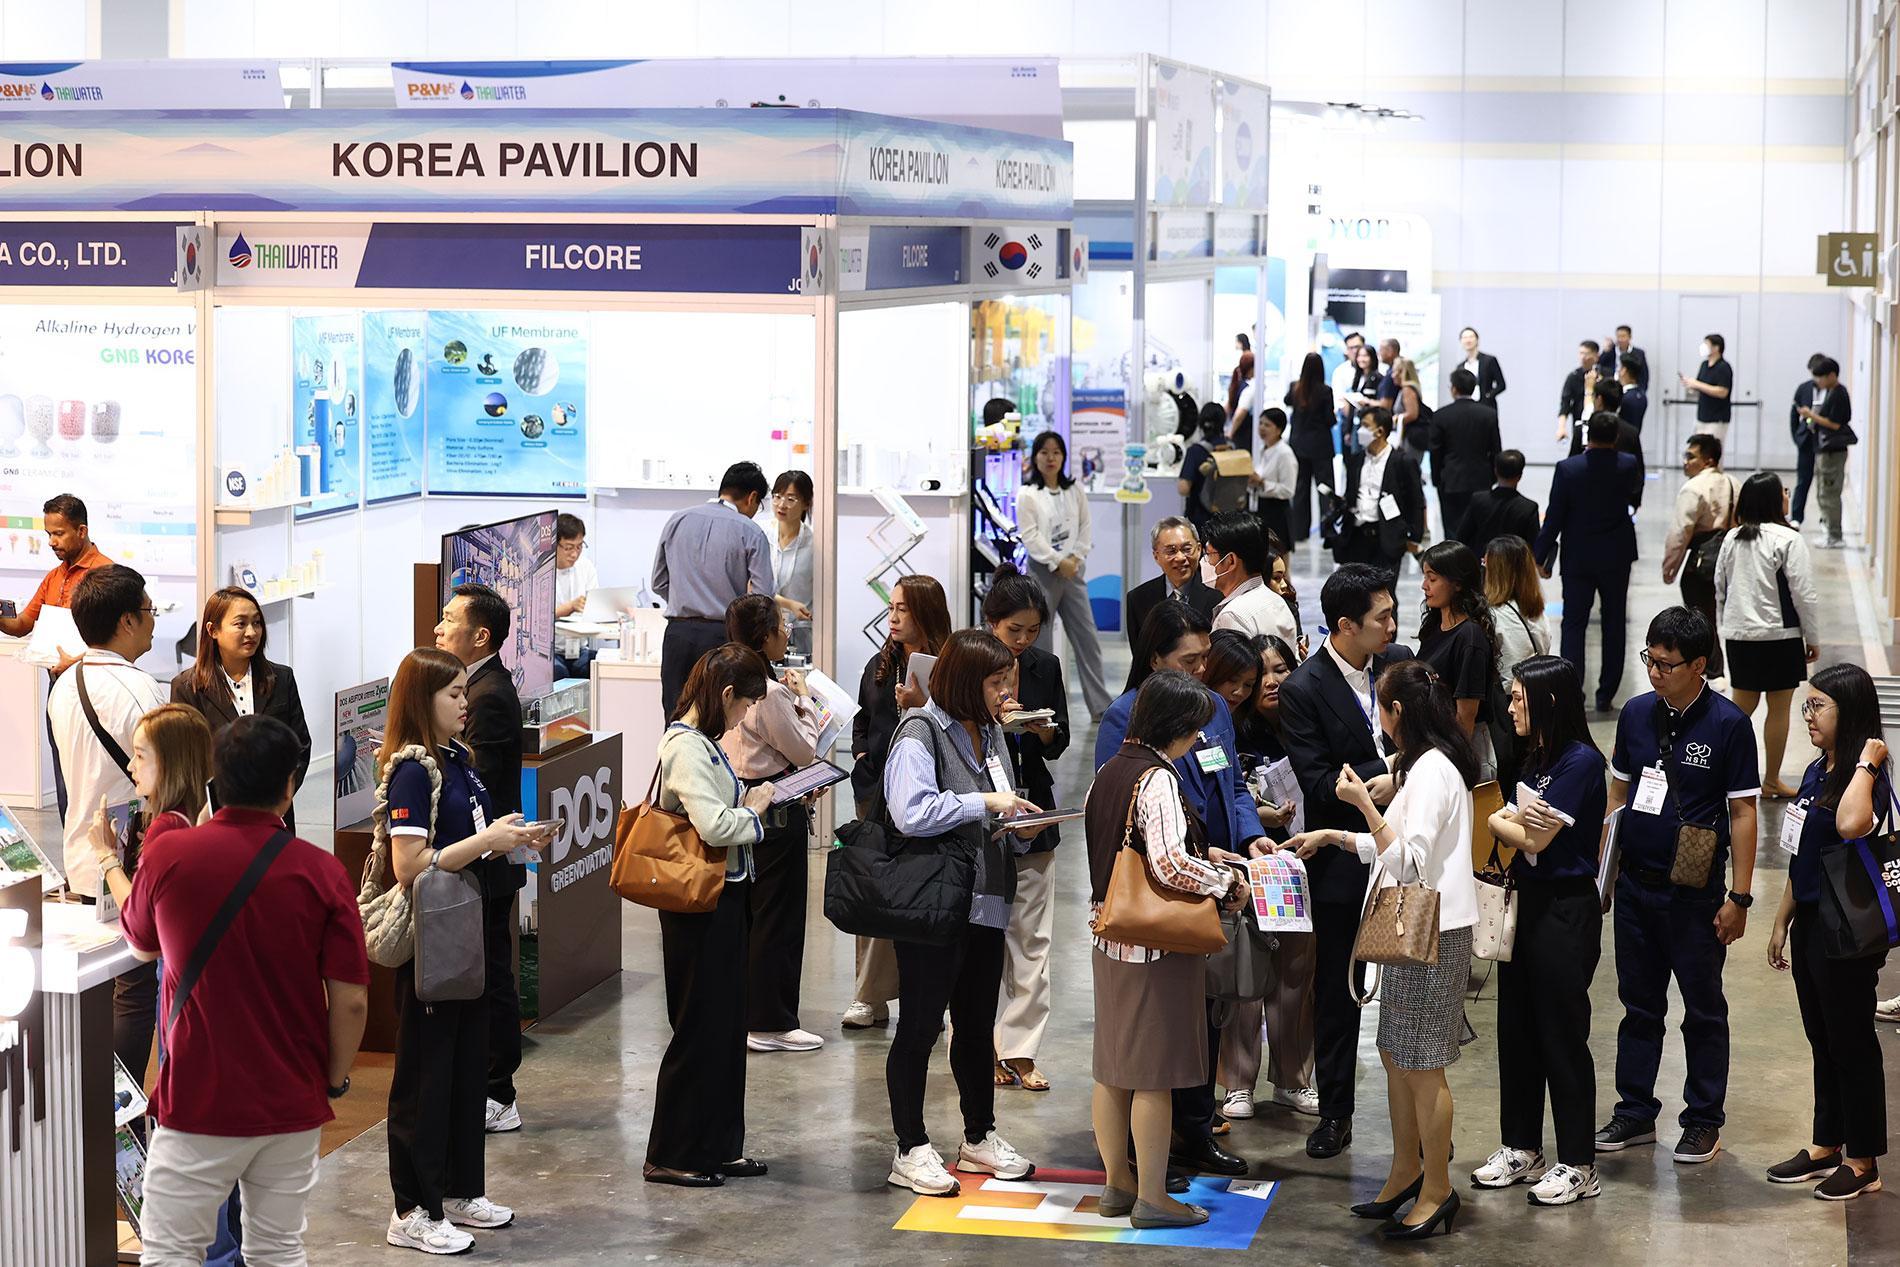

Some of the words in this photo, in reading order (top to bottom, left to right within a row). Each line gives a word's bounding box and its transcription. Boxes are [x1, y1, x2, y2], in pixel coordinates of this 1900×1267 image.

[55, 86, 103, 101] THAIWATER
[475, 85, 527, 100] THAIWATER
[332, 142, 485, 178] KOREA
[500, 142, 698, 178] PAVILION
[869, 147, 905, 182] KOREA
[907, 150, 949, 184] PAVILION
[995, 160, 1022, 189] KOREA
[1024, 162, 1056, 192] PAVILION
[20, 242, 69, 270] CO.,
[78, 242, 127, 265] LTD.
[254, 244, 338, 270] THAIWATER
[526, 245, 641, 270] FILCORE
[902, 245, 928, 268] FILCORE
[35, 320, 97, 334] Alkaline
[104, 322, 180, 338] Hydrogen
[492, 327, 508, 338] UF
[511, 326, 578, 338] Membrane
[1685, 755, 1707, 765] NSM
[551, 766, 613, 864] DOS
[551, 843, 613, 893] GREENOVATION
